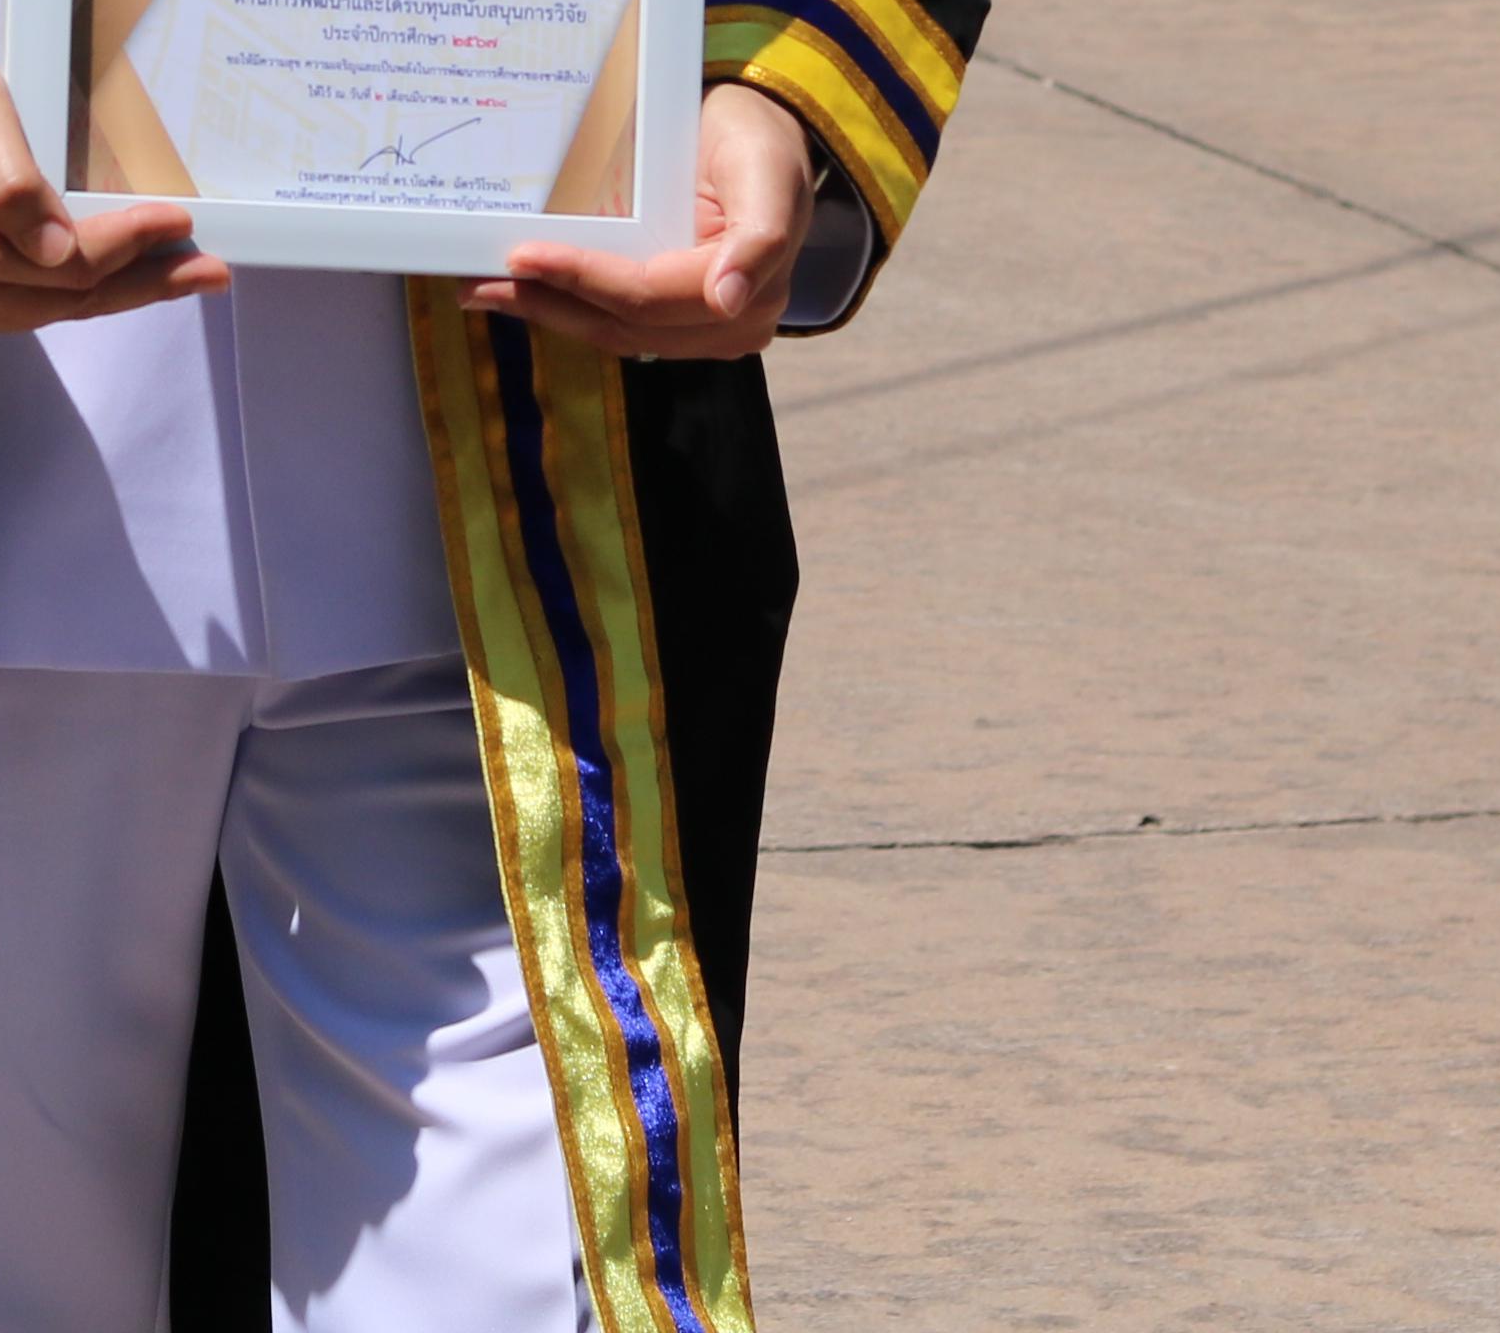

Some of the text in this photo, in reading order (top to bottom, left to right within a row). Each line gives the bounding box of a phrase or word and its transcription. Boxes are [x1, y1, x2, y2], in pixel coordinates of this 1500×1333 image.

[323, 24, 447, 47] ประจำปีการศึกษา
